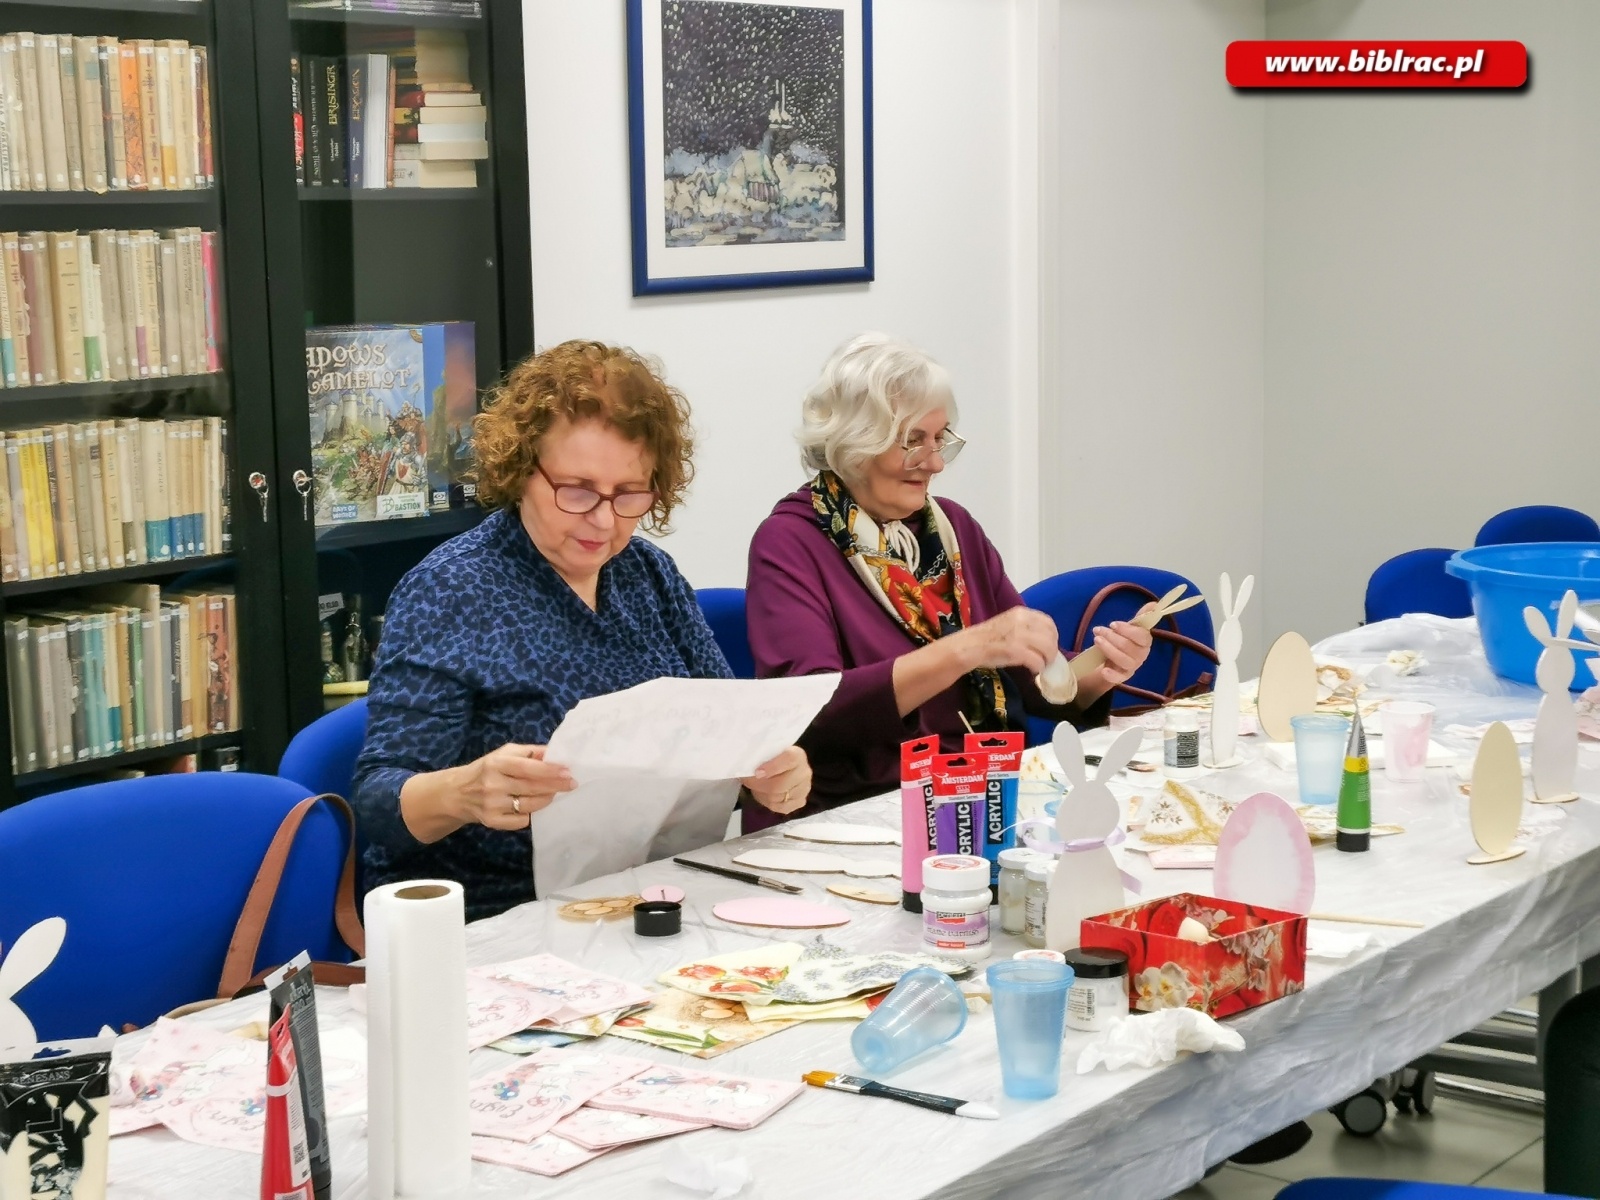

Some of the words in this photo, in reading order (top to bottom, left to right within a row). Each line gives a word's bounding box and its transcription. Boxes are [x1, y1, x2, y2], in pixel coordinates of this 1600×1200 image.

[326, 64, 339, 125] BRISINGR
[307, 368, 412, 395] CAMELOT
[395, 502, 421, 512] BASTION
[941, 774, 985, 785] AMSTERDAM
[926, 786, 937, 847] ACRYLIC
[959, 804, 972, 856] CRYLIC
[988, 781, 1002, 842] ACRYLIC
[12, 1070, 71, 1085] RENESANS
[26, 1107, 64, 1200] RYL
